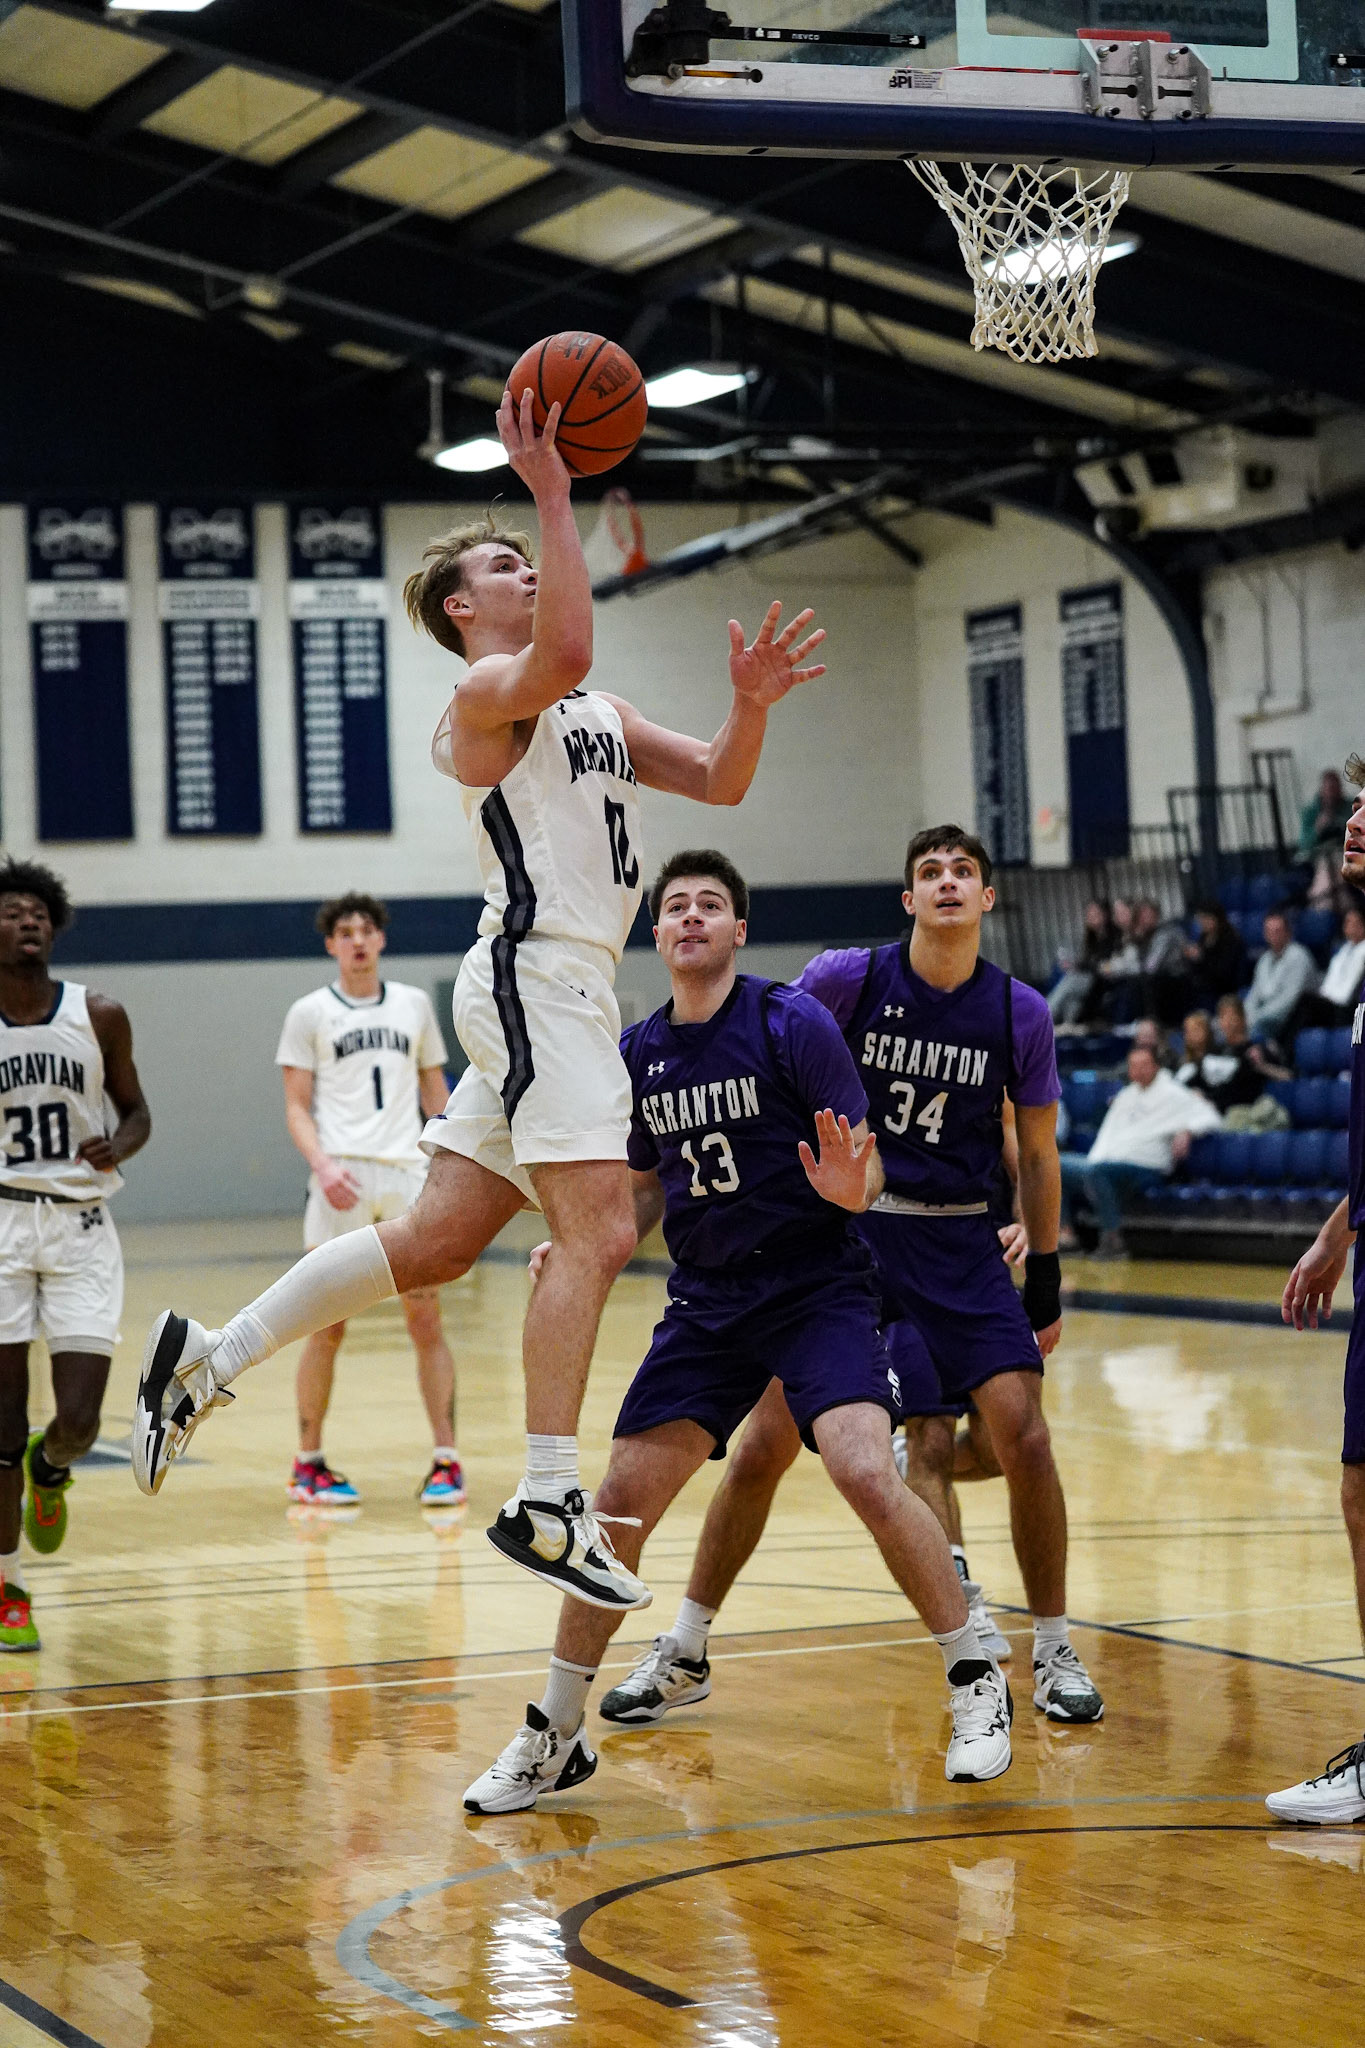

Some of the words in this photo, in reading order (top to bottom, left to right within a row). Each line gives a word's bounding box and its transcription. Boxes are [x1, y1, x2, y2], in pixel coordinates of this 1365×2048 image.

[372, 1065, 383, 1110] 1
[862, 1031, 988, 1086] SCRANTON
[4, 1102, 70, 1166] 30
[641, 1076, 760, 1135] SCRANTON
[884, 1080, 949, 1144] 34
[681, 1131, 740, 1197] 13
